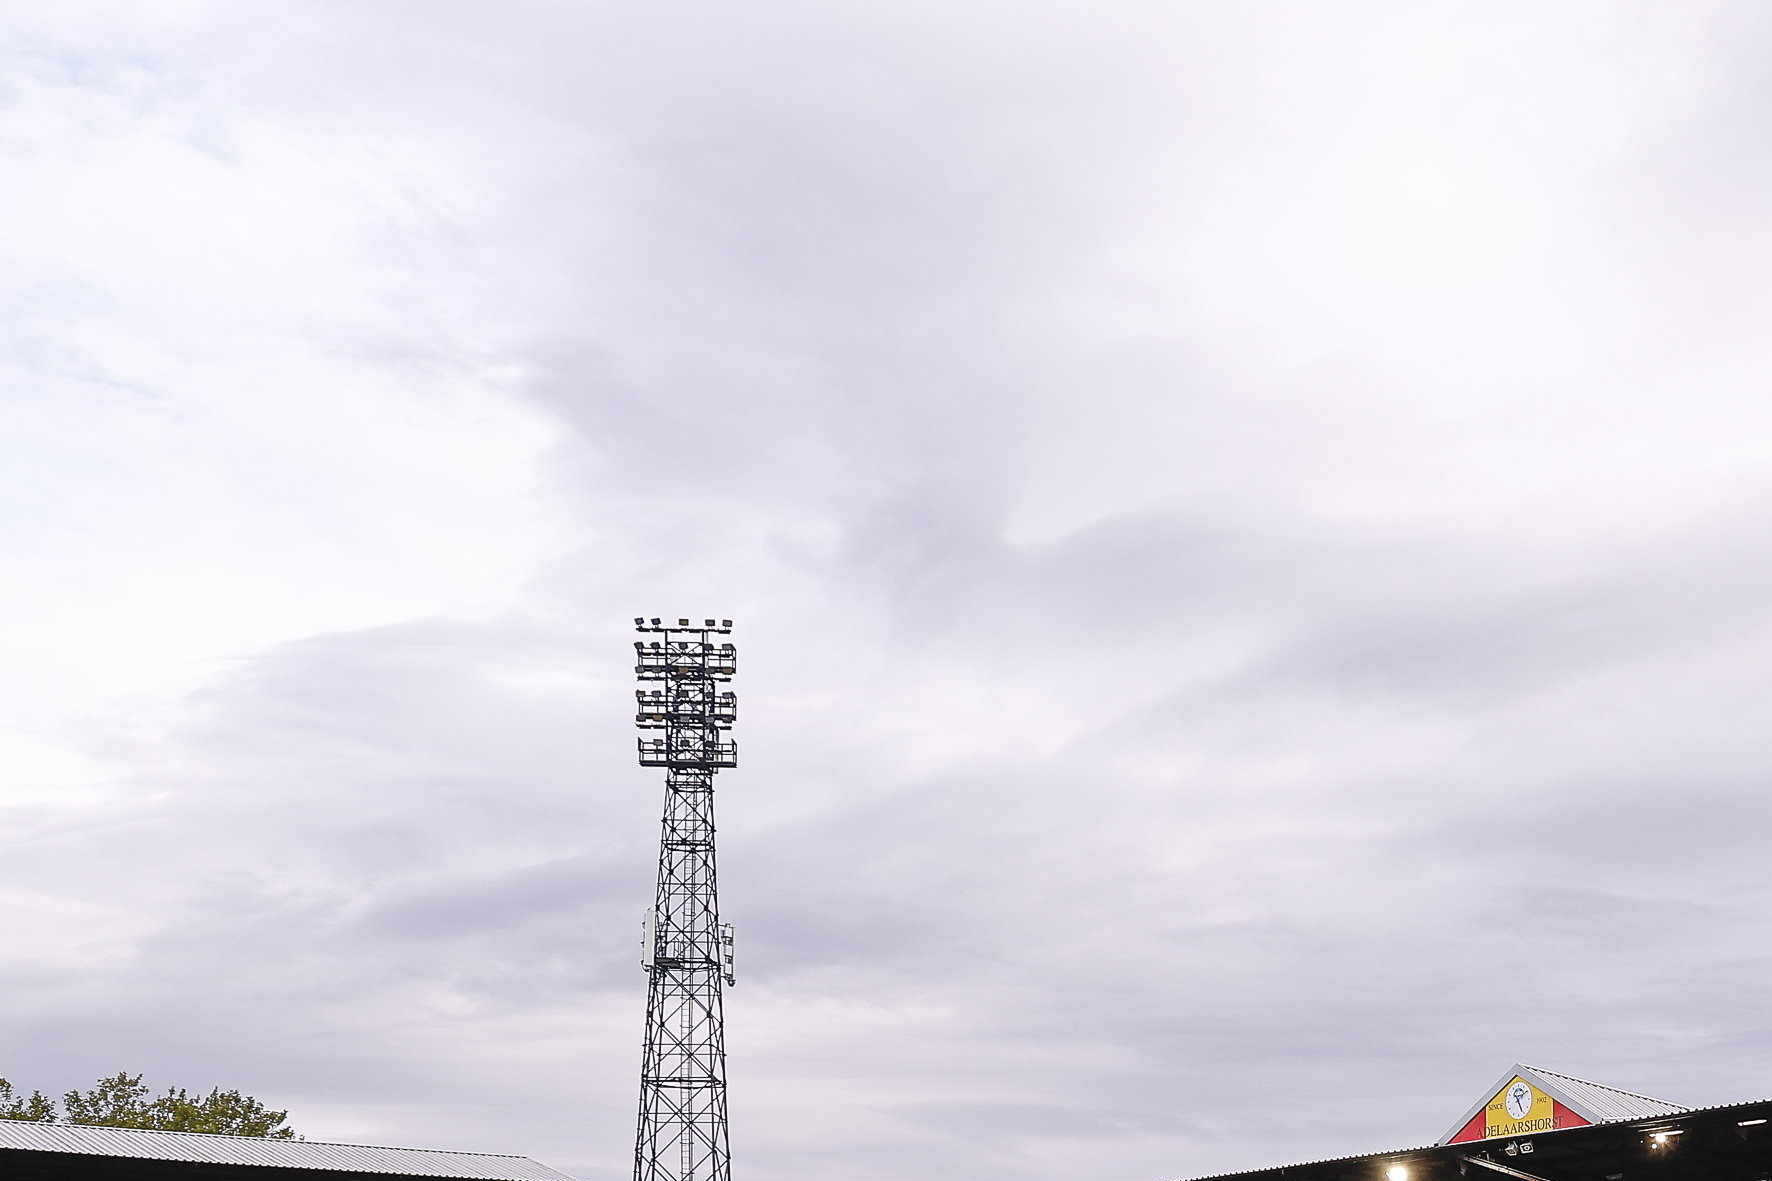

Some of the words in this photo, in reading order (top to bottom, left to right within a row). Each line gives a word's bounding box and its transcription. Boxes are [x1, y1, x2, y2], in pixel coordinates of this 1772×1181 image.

[1488, 1103, 1504, 1111] SINCE
[1536, 1096, 1547, 1104] 1902
[1476, 1116, 1564, 1138] ADELAARSHORST
